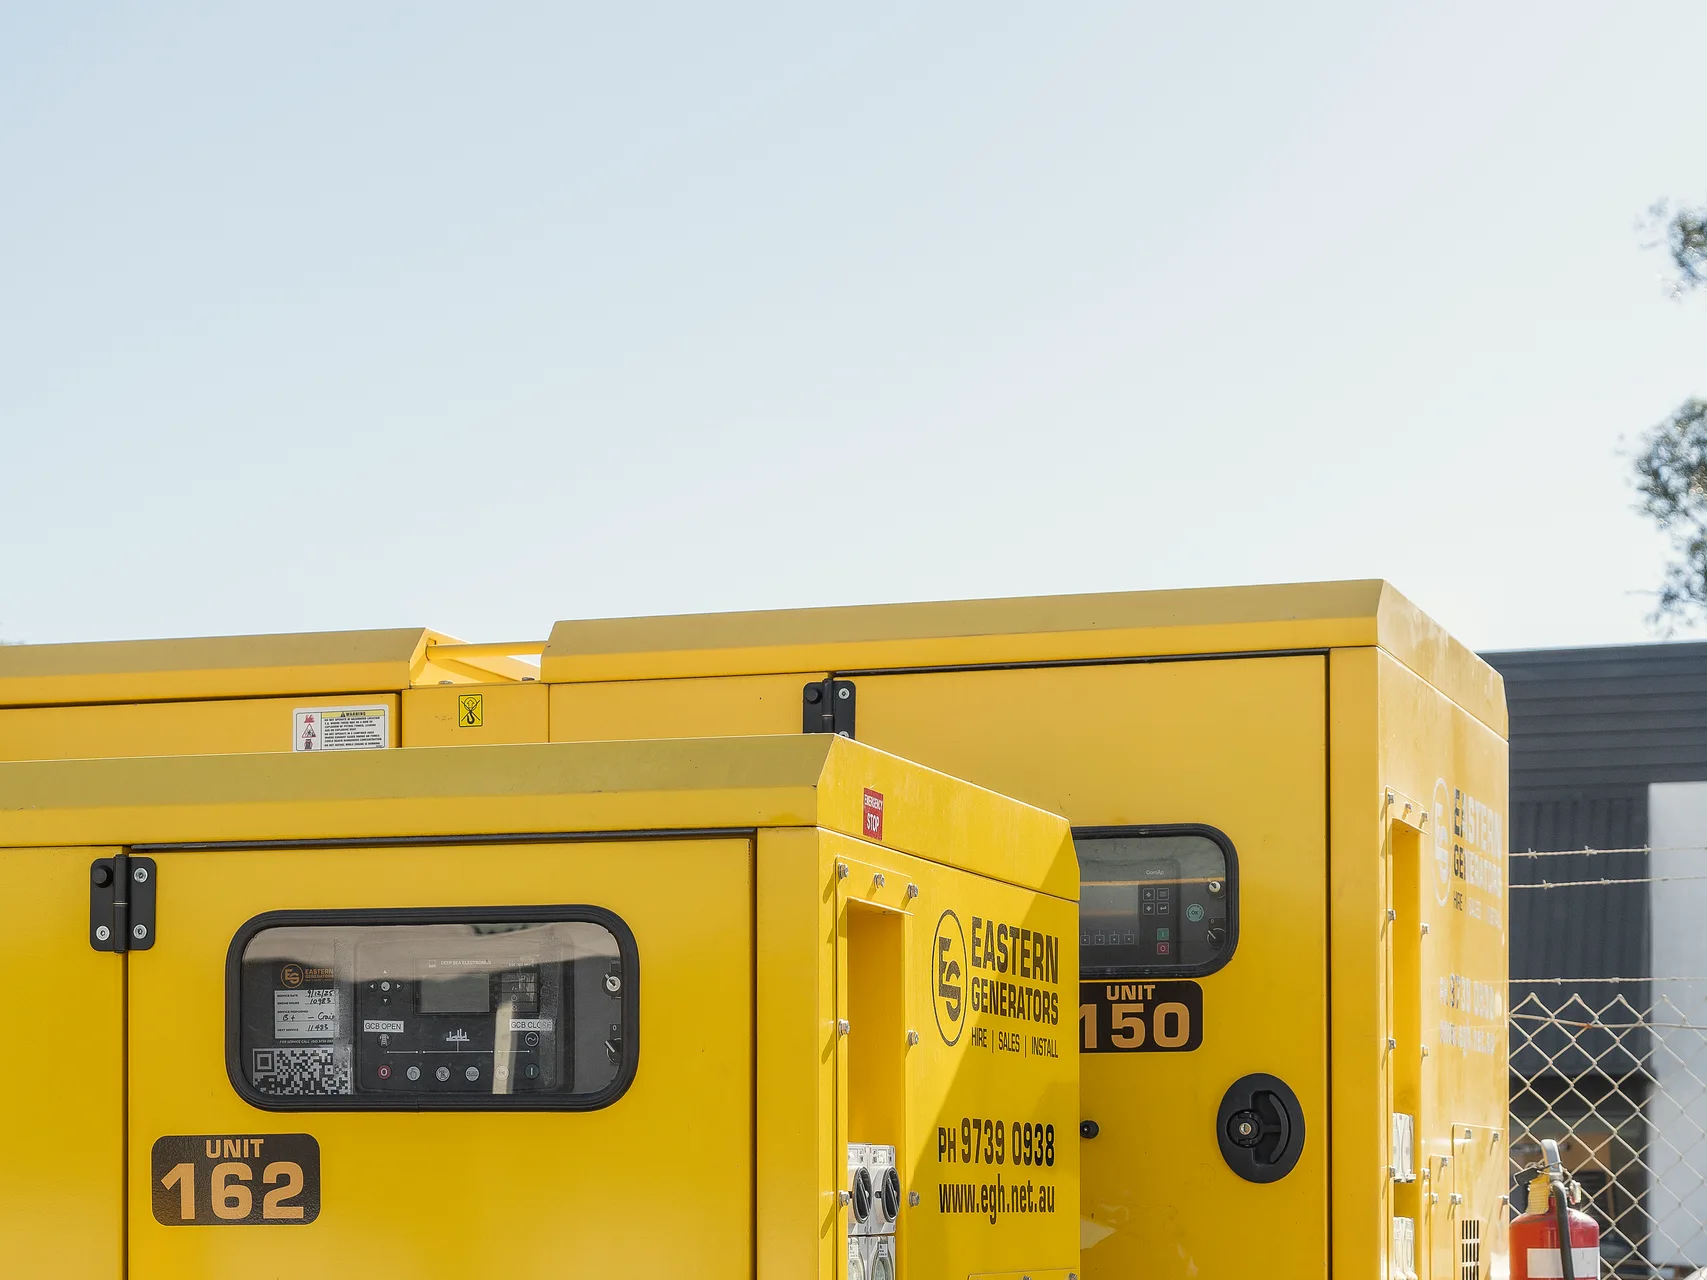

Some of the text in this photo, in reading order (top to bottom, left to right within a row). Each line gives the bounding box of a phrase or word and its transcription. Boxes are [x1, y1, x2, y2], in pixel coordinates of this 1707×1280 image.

[867, 812, 880, 833] STOP
[971, 916, 1059, 985] EASTERN
[971, 976, 1059, 1026] GENERATORS
[1106, 984, 1156, 1001] UNIT
[364, 1022, 401, 1030] GCB OPEN
[510, 1021, 526, 1029] GCB
[971, 1026, 1059, 1059] HIRE SALES INSTALL
[1079, 1002, 1190, 1049] 150
[205, 1138, 264, 1159] UNIT
[938, 1117, 1055, 1167] PH 9739 0938
[160, 1161, 304, 1220] 162
[938, 1173, 1055, 1225] www.egh.net.au
